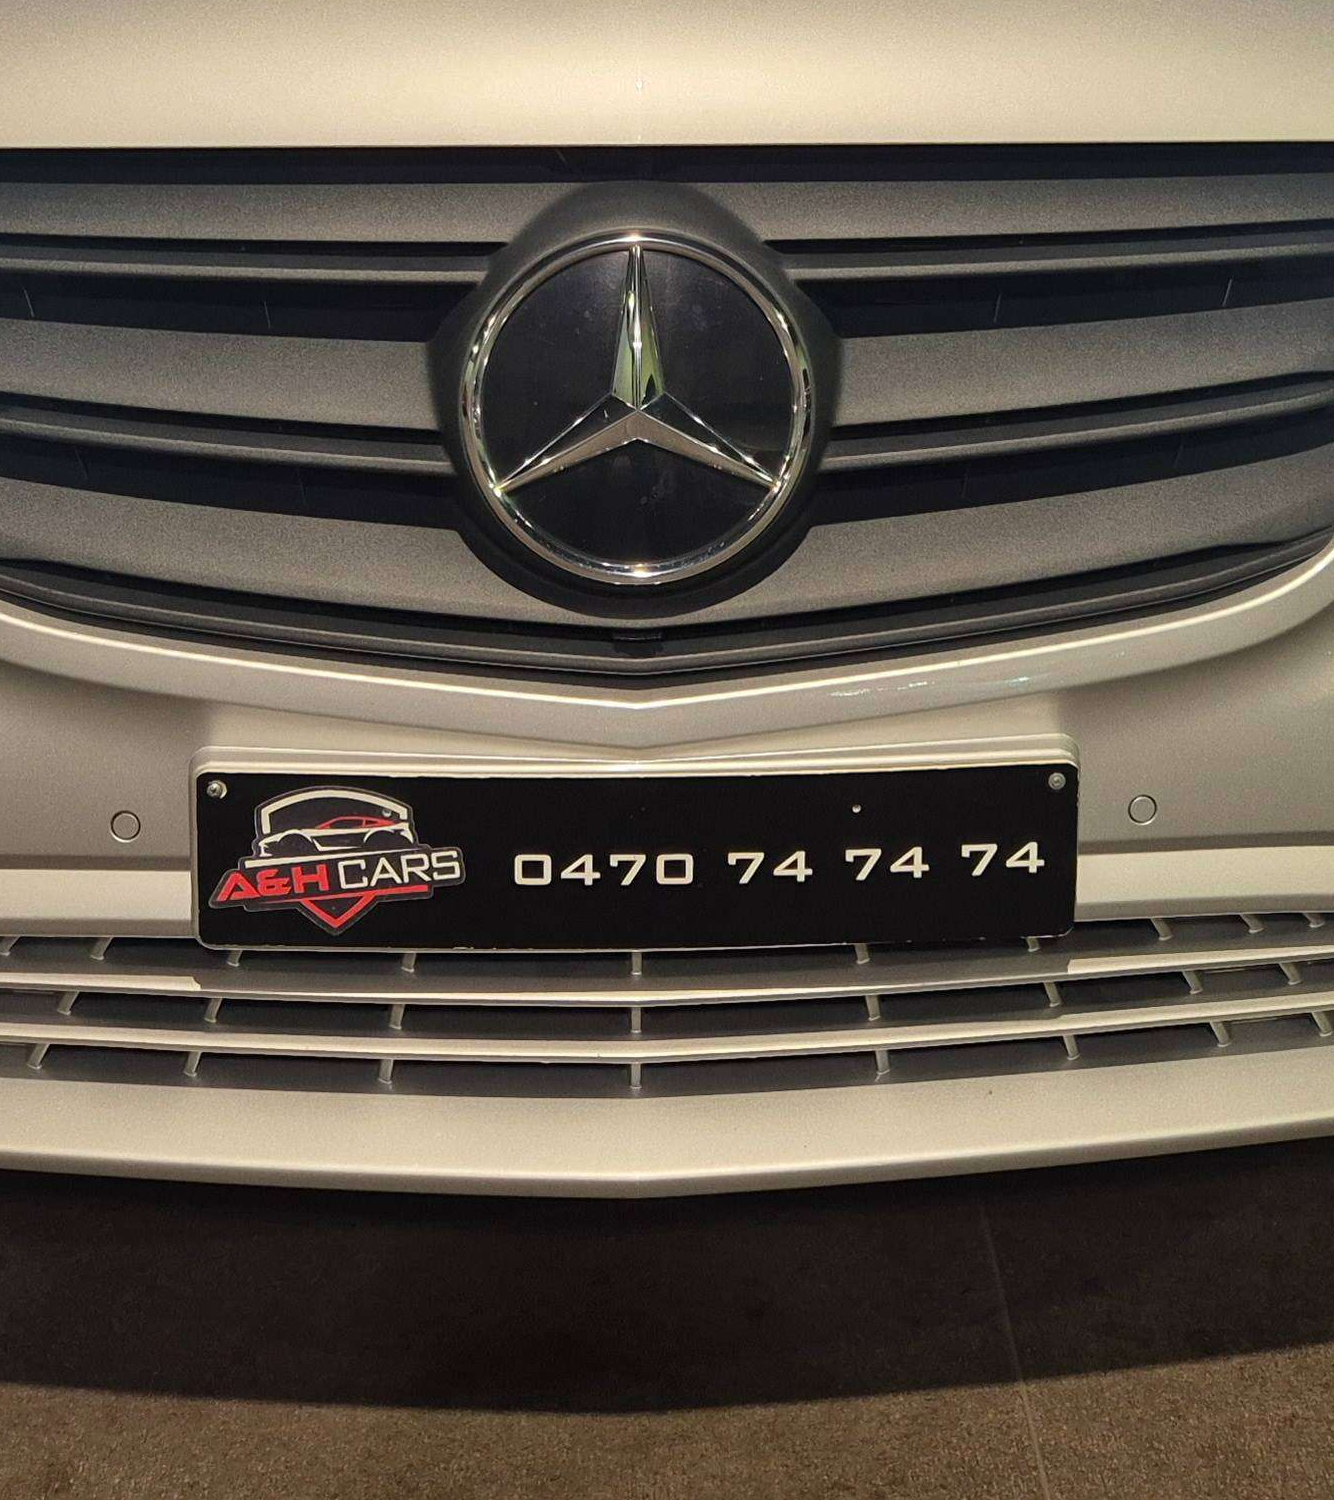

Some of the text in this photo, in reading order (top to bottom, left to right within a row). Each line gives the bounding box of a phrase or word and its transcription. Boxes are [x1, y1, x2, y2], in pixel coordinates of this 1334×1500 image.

[217, 851, 461, 901] A&H CARS
[514, 841, 1045, 886] 0470 74 74 74
